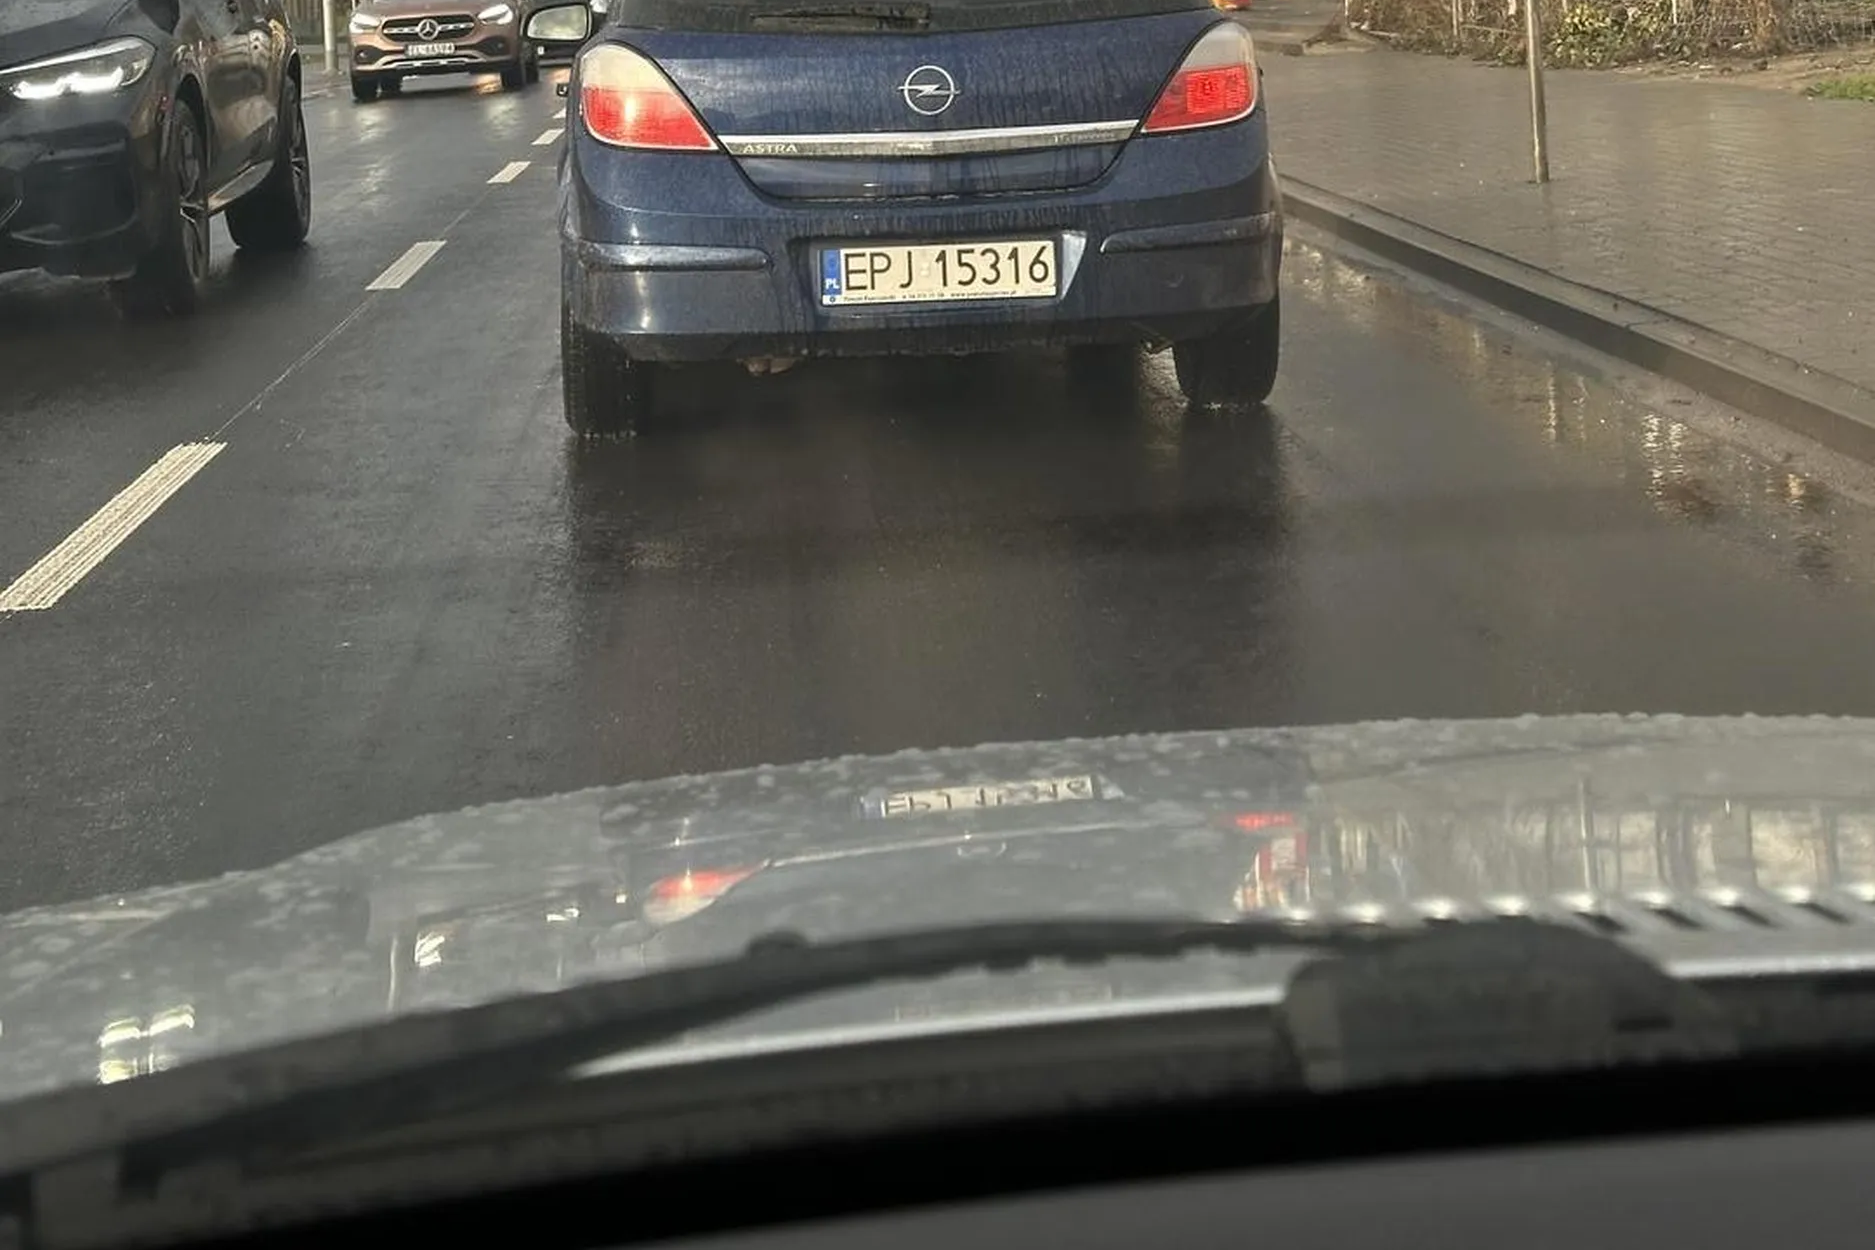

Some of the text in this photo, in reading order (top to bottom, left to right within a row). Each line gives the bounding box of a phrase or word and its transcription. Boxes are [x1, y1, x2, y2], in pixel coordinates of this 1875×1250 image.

[742, 144, 798, 154] ASTRA
[844, 246, 1049, 291] EPJ 15316
[825, 278, 840, 289] PL
